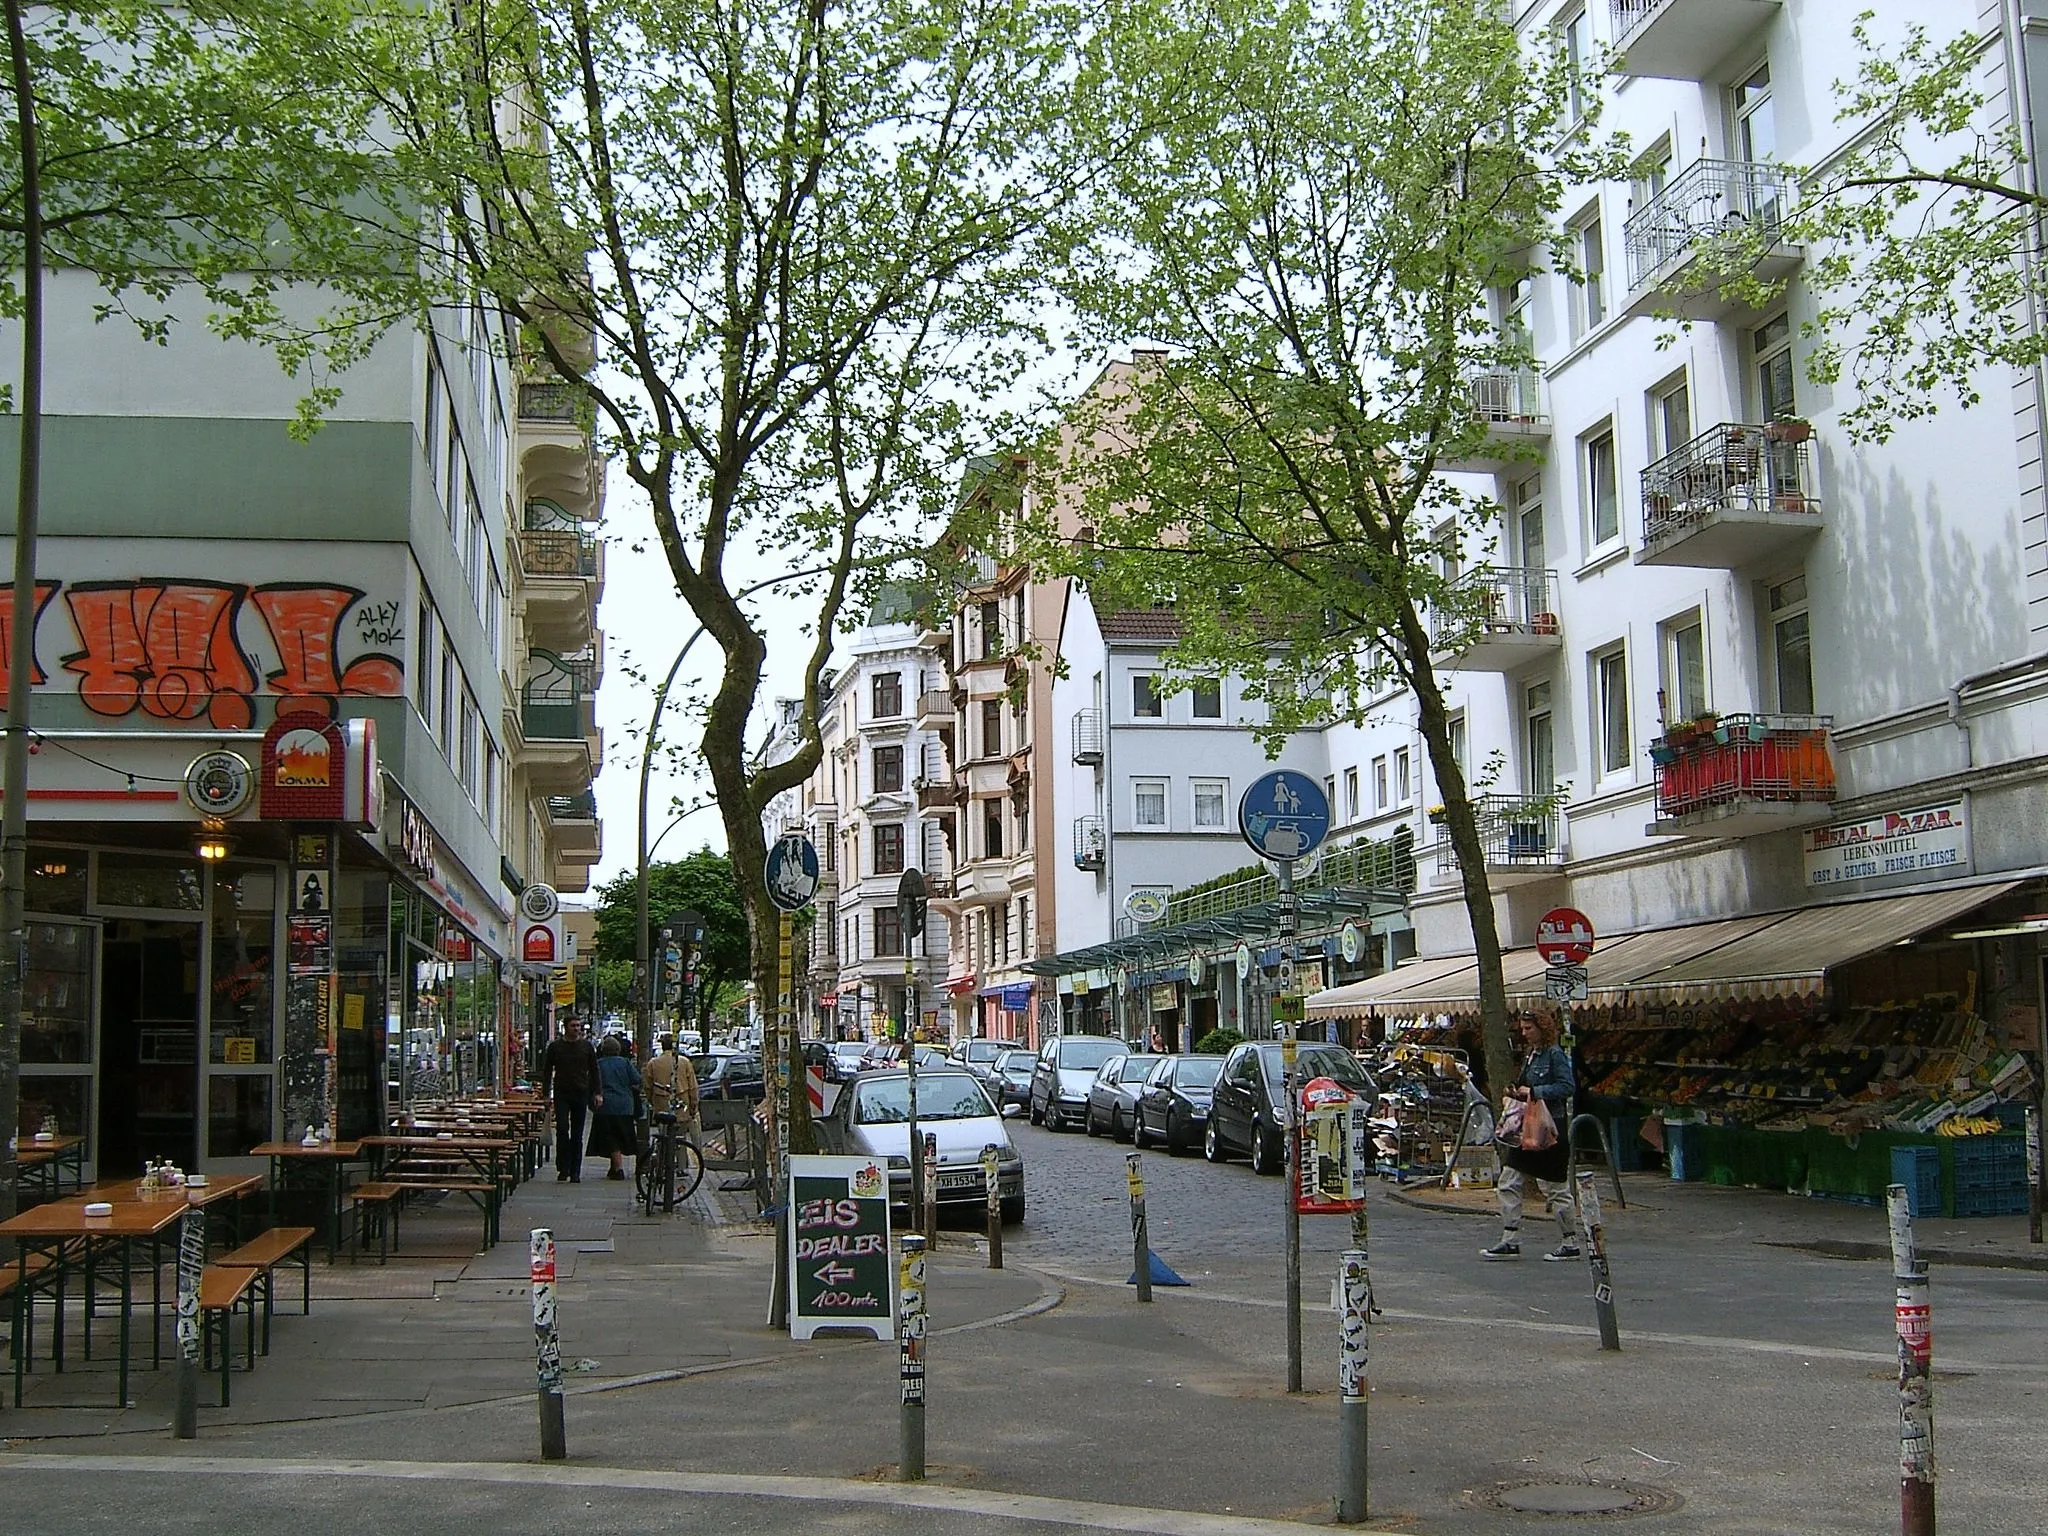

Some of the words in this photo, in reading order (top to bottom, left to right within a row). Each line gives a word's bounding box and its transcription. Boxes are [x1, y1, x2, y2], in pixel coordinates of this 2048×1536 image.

[1884, 810, 1954, 839] PAZAR
[1843, 836, 1918, 862] LEBENSMITTEL
[1812, 867, 1832, 885] OBST
[1834, 867, 1841, 880] &
[1919, 849, 1957, 867] FLEISCH
[954, 1174, 976, 1187] 1534
[796, 1233, 888, 1260] DEALER
